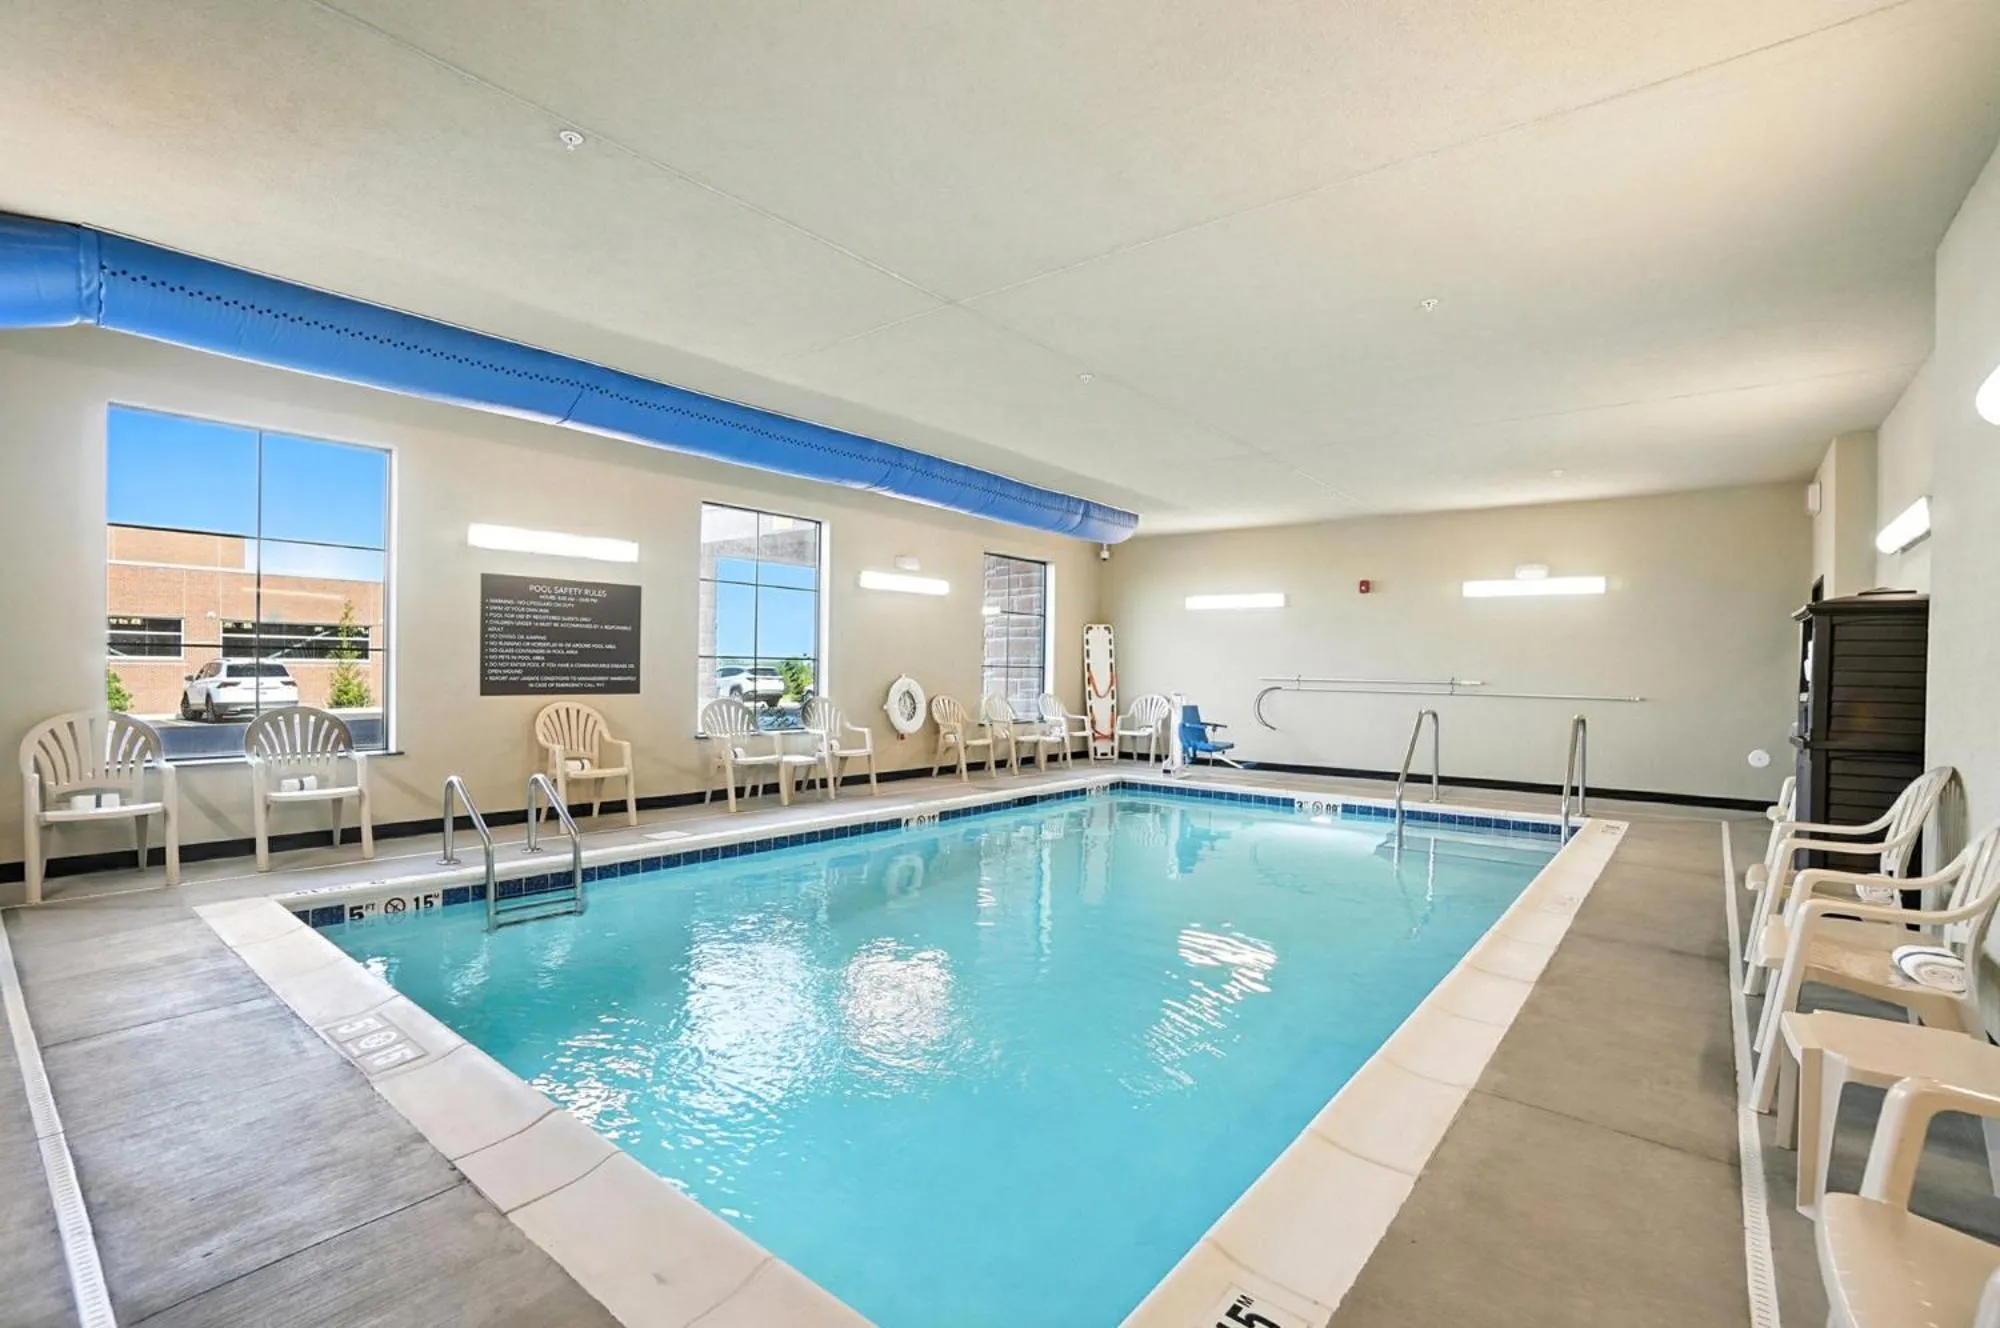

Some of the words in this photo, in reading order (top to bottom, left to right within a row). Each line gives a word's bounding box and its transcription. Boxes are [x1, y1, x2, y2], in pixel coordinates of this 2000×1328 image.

[528, 584, 553, 594] POOL
[553, 586, 583, 596] SAFETY
[584, 588, 608, 599] RULES
